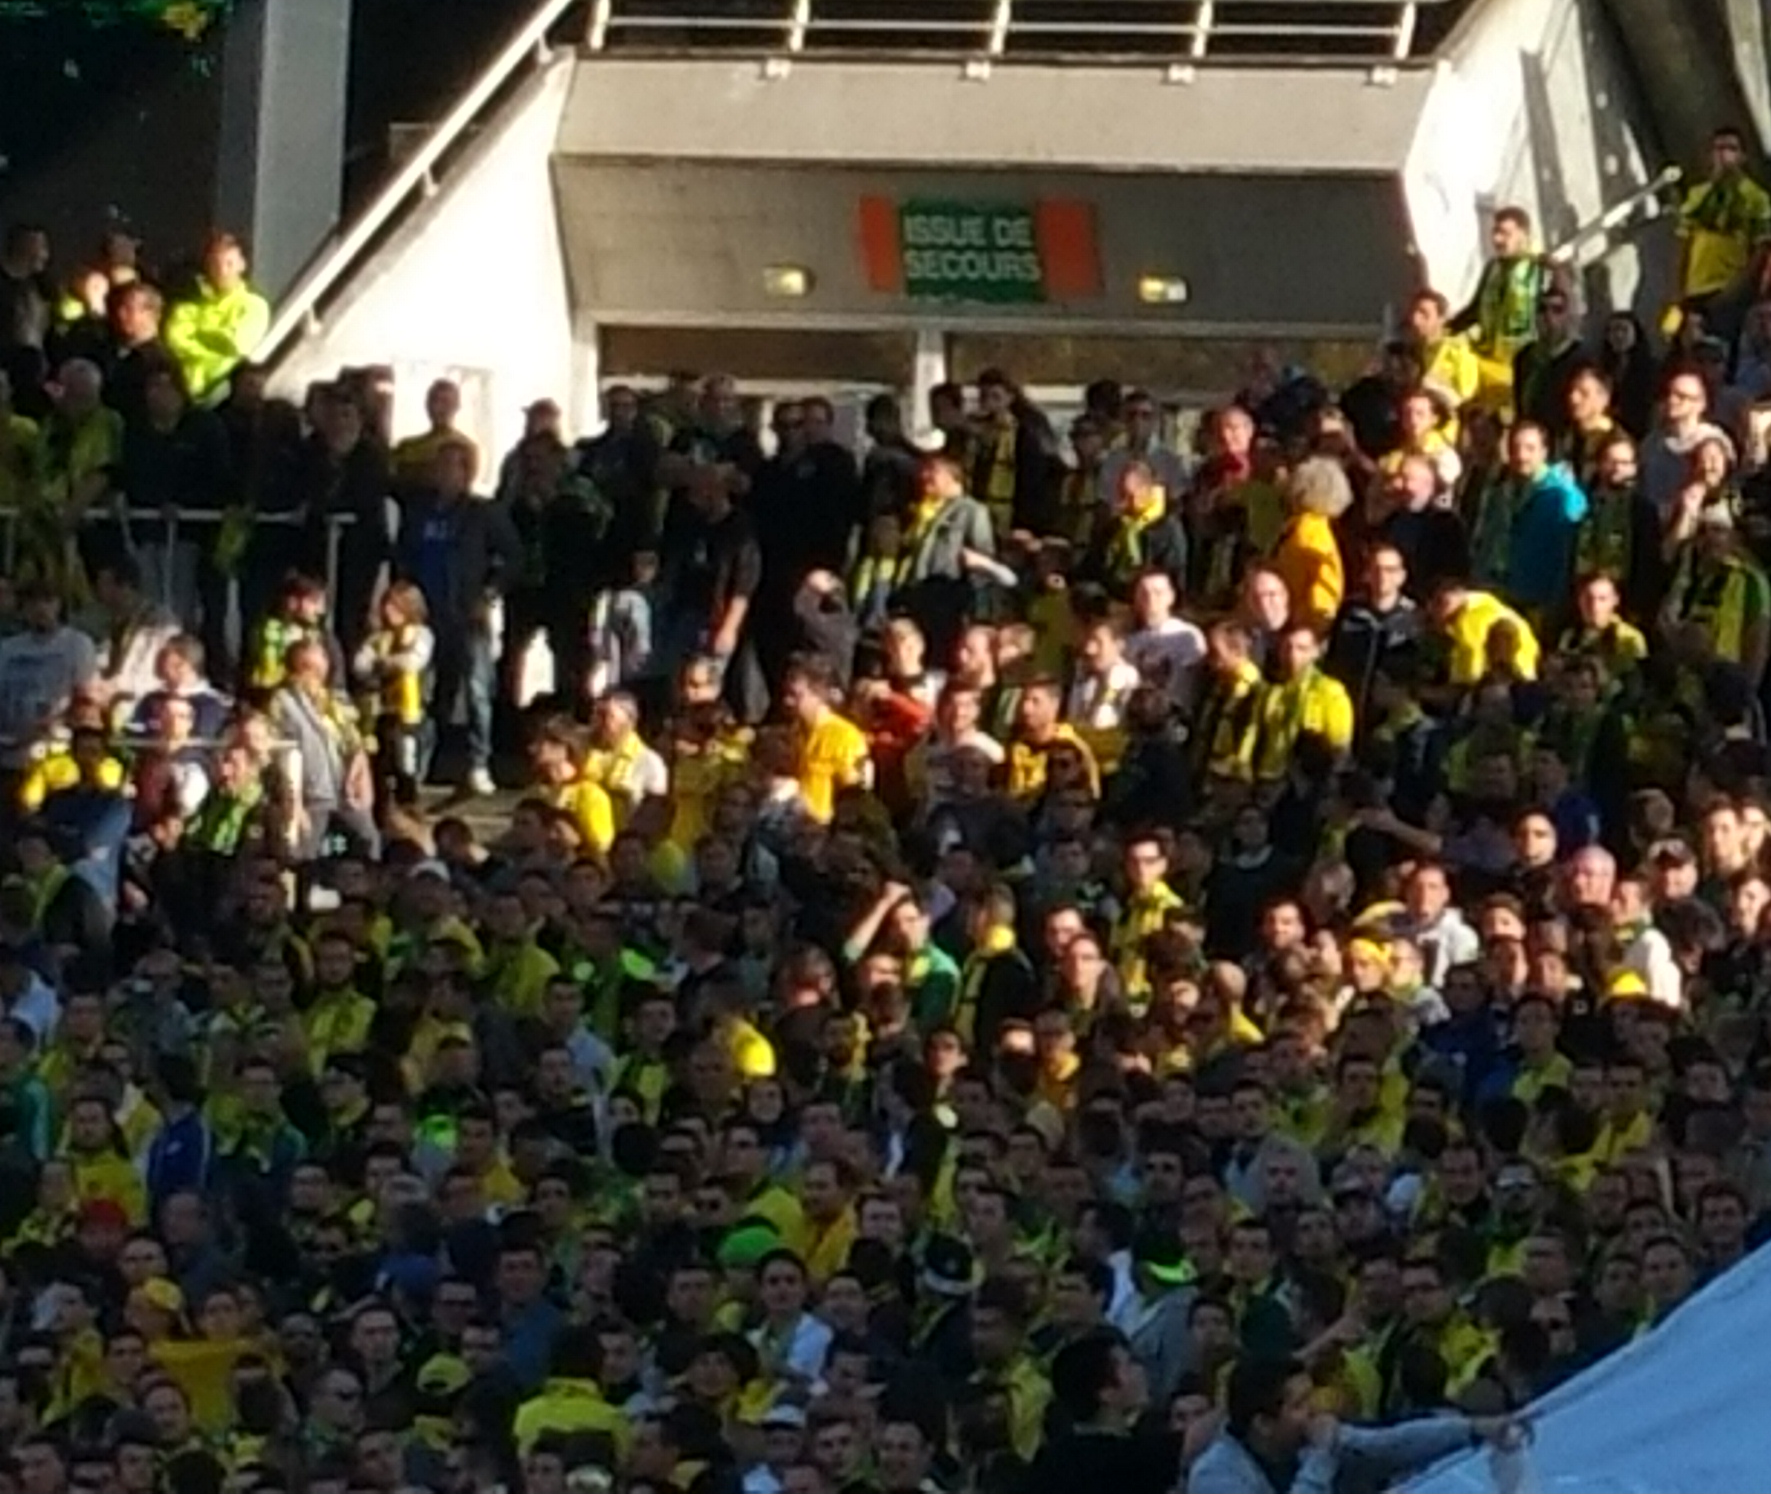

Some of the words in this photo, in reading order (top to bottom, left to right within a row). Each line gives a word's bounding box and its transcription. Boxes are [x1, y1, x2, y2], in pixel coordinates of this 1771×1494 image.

[904, 215, 986, 247] ISSUE
[993, 217, 1033, 247] DE
[903, 250, 1042, 281] SECOURS
